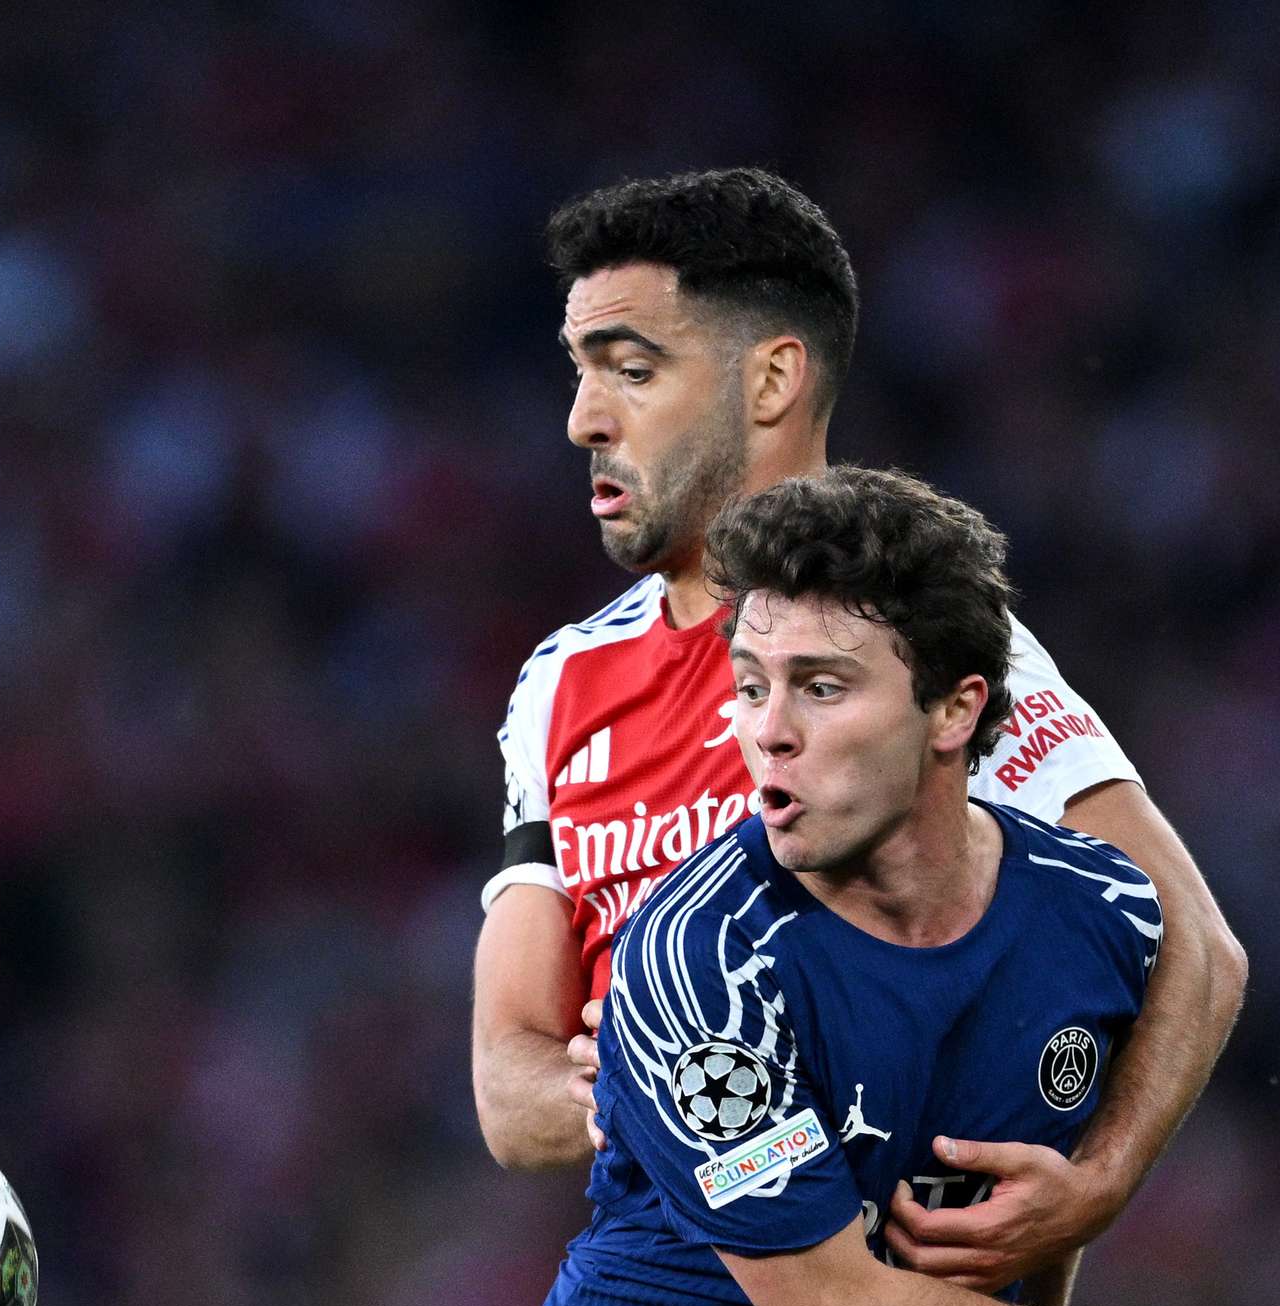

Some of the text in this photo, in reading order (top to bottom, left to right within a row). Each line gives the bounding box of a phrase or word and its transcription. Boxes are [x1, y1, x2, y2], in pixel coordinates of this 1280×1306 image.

[1001, 689, 1065, 738] VISIT
[994, 713, 1104, 792] RWANDA
[1050, 1031, 1091, 1053] PARIS
[699, 1161, 725, 1179] UEFA
